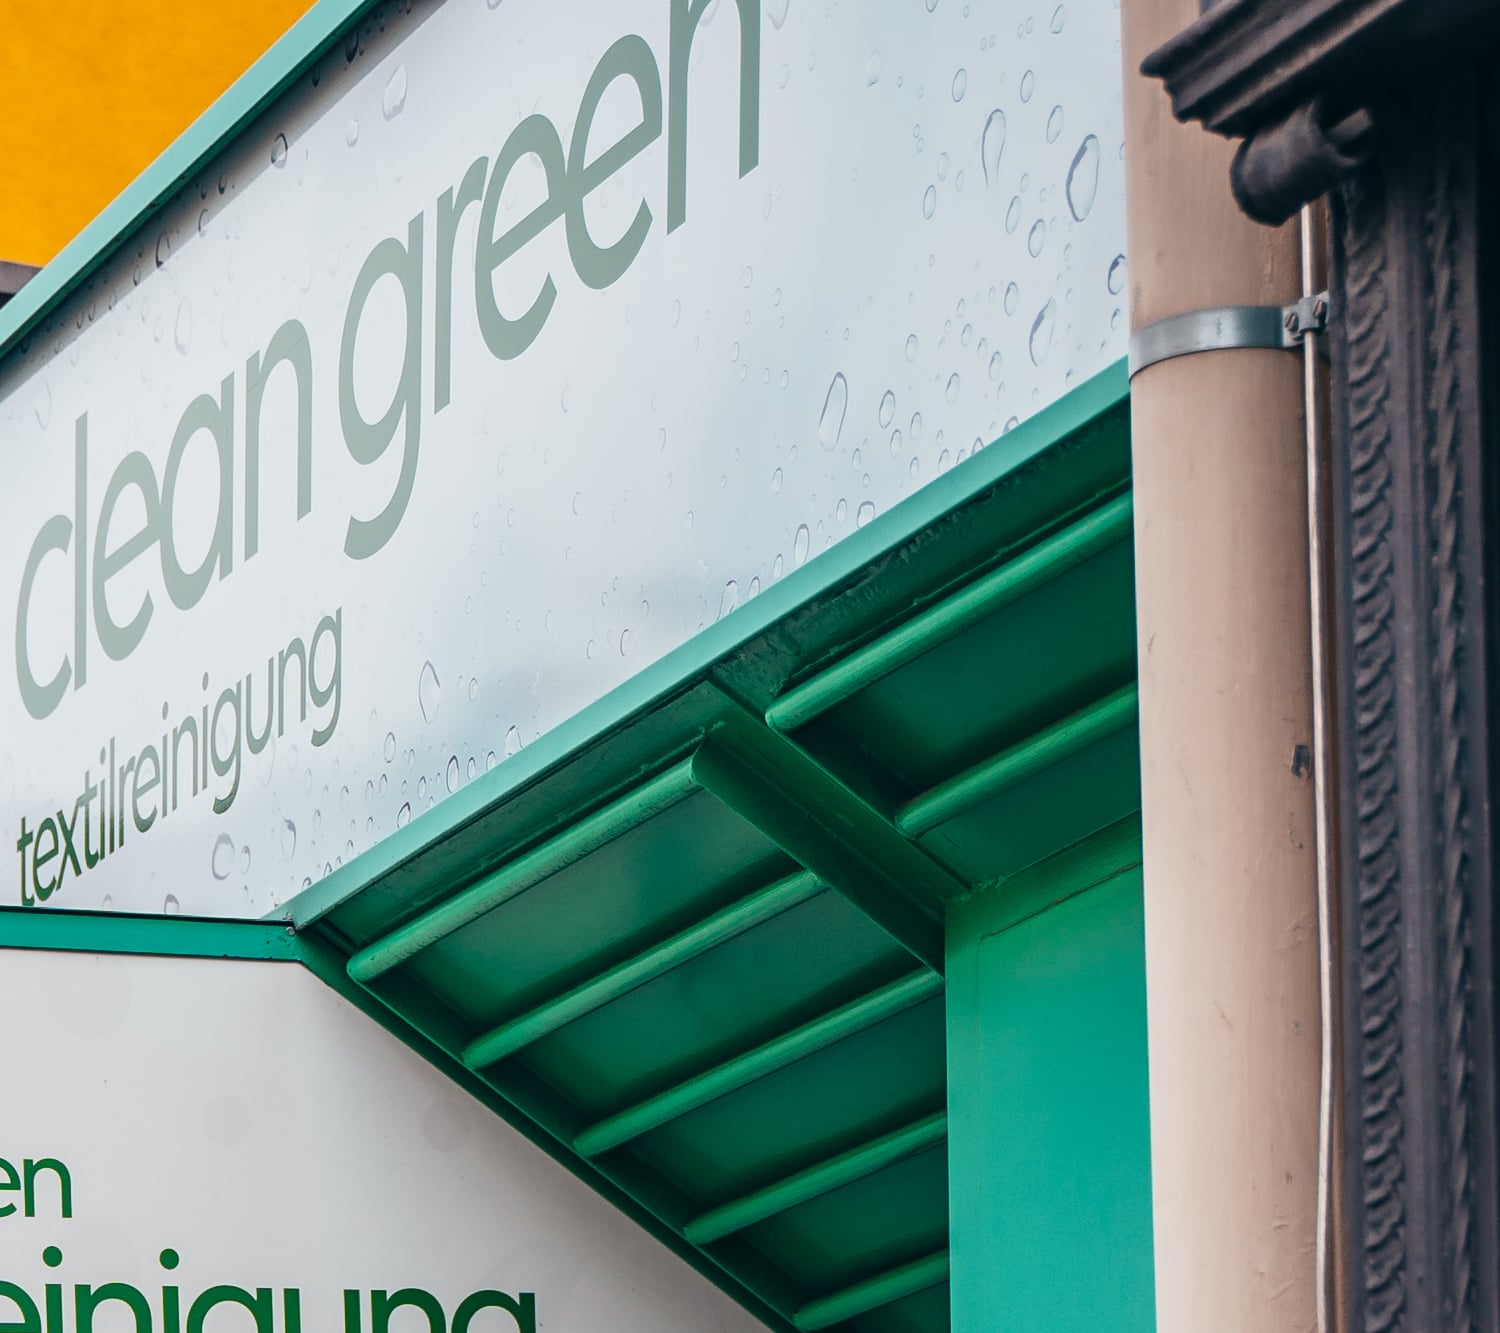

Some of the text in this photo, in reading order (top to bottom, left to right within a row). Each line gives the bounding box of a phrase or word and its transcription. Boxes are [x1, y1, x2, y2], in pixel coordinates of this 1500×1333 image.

[14, 0, 762, 721] clean green
[16, 605, 343, 907] textilreinigung
